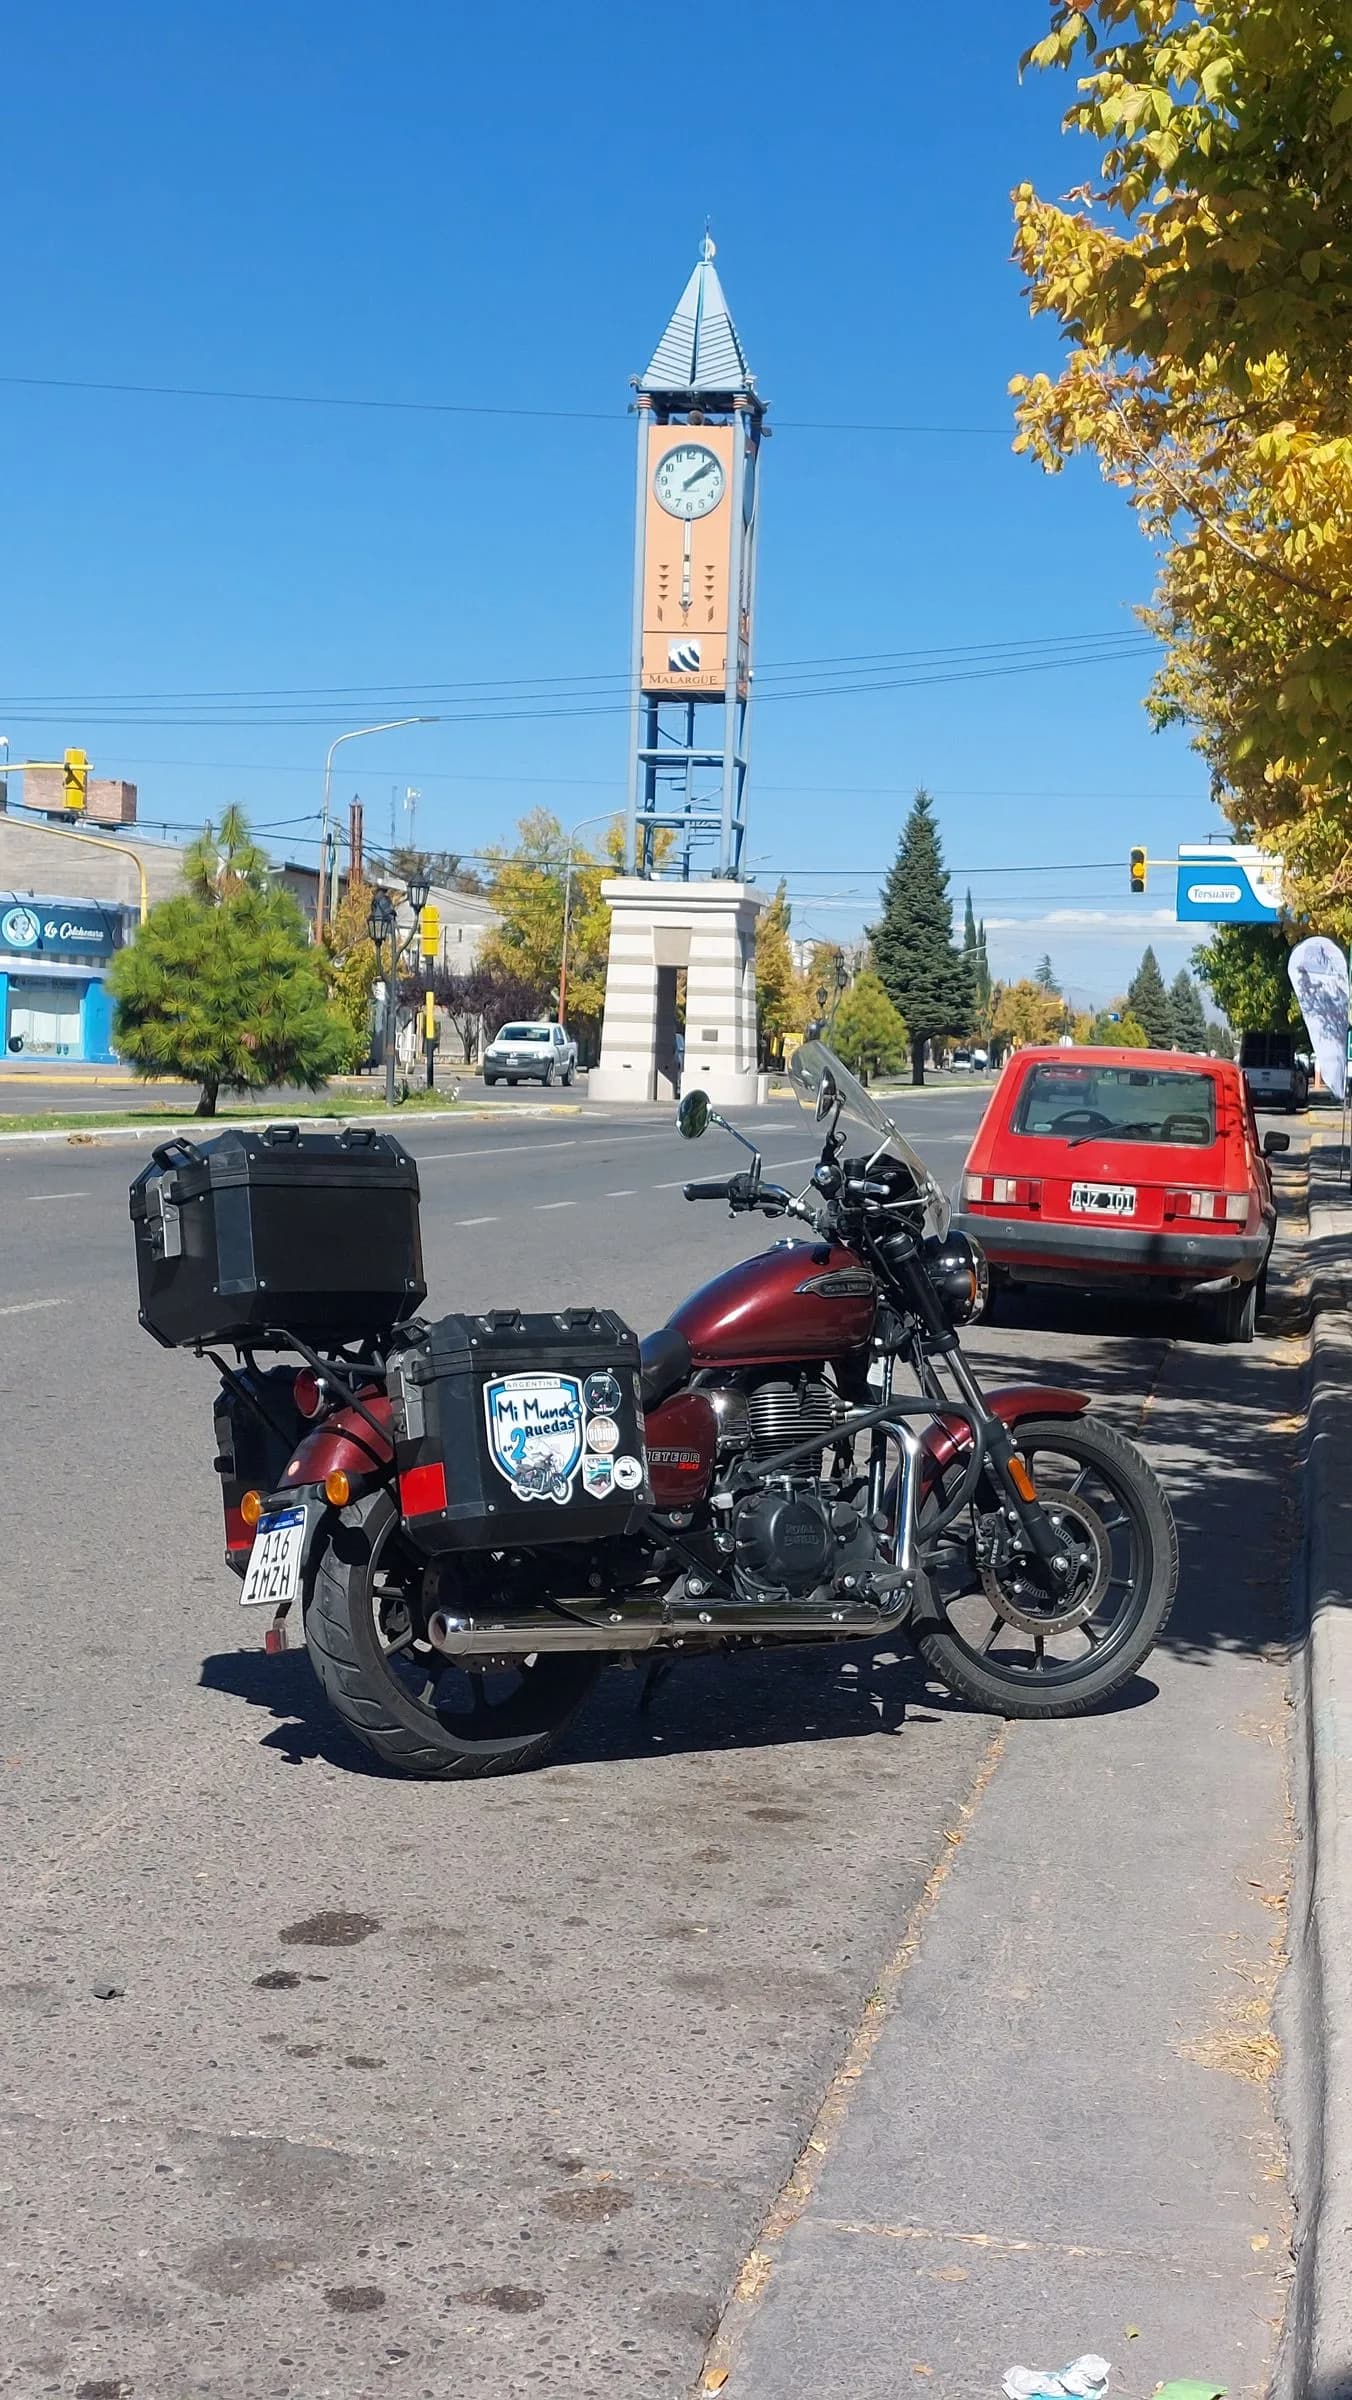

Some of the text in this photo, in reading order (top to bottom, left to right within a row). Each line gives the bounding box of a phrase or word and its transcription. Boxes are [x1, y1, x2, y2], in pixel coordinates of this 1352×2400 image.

[676, 453, 682, 463] 11
[686, 449, 696, 460] 12
[665, 463, 674, 472] 10
[661, 476, 668, 486] 9
[712, 476, 719, 486] 3
[665, 489, 671, 499] 8
[707, 489, 714, 499] 4
[675, 498, 682, 508] 7
[686, 502, 693, 512] 6
[698, 499, 705, 509] 5
[1193, 888, 1236, 899] Tersuave
[1073, 1191, 1132, 1210] AJZ 101
[506, 1380, 559, 1389] ARGENTINA
[497, 1400, 519, 1423] Mi
[511, 1427, 527, 1460] 2
[524, 1419, 575, 1438] Ruedas
[260, 1529, 291, 1565] A16
[247, 1563, 291, 1600] 1MZH
